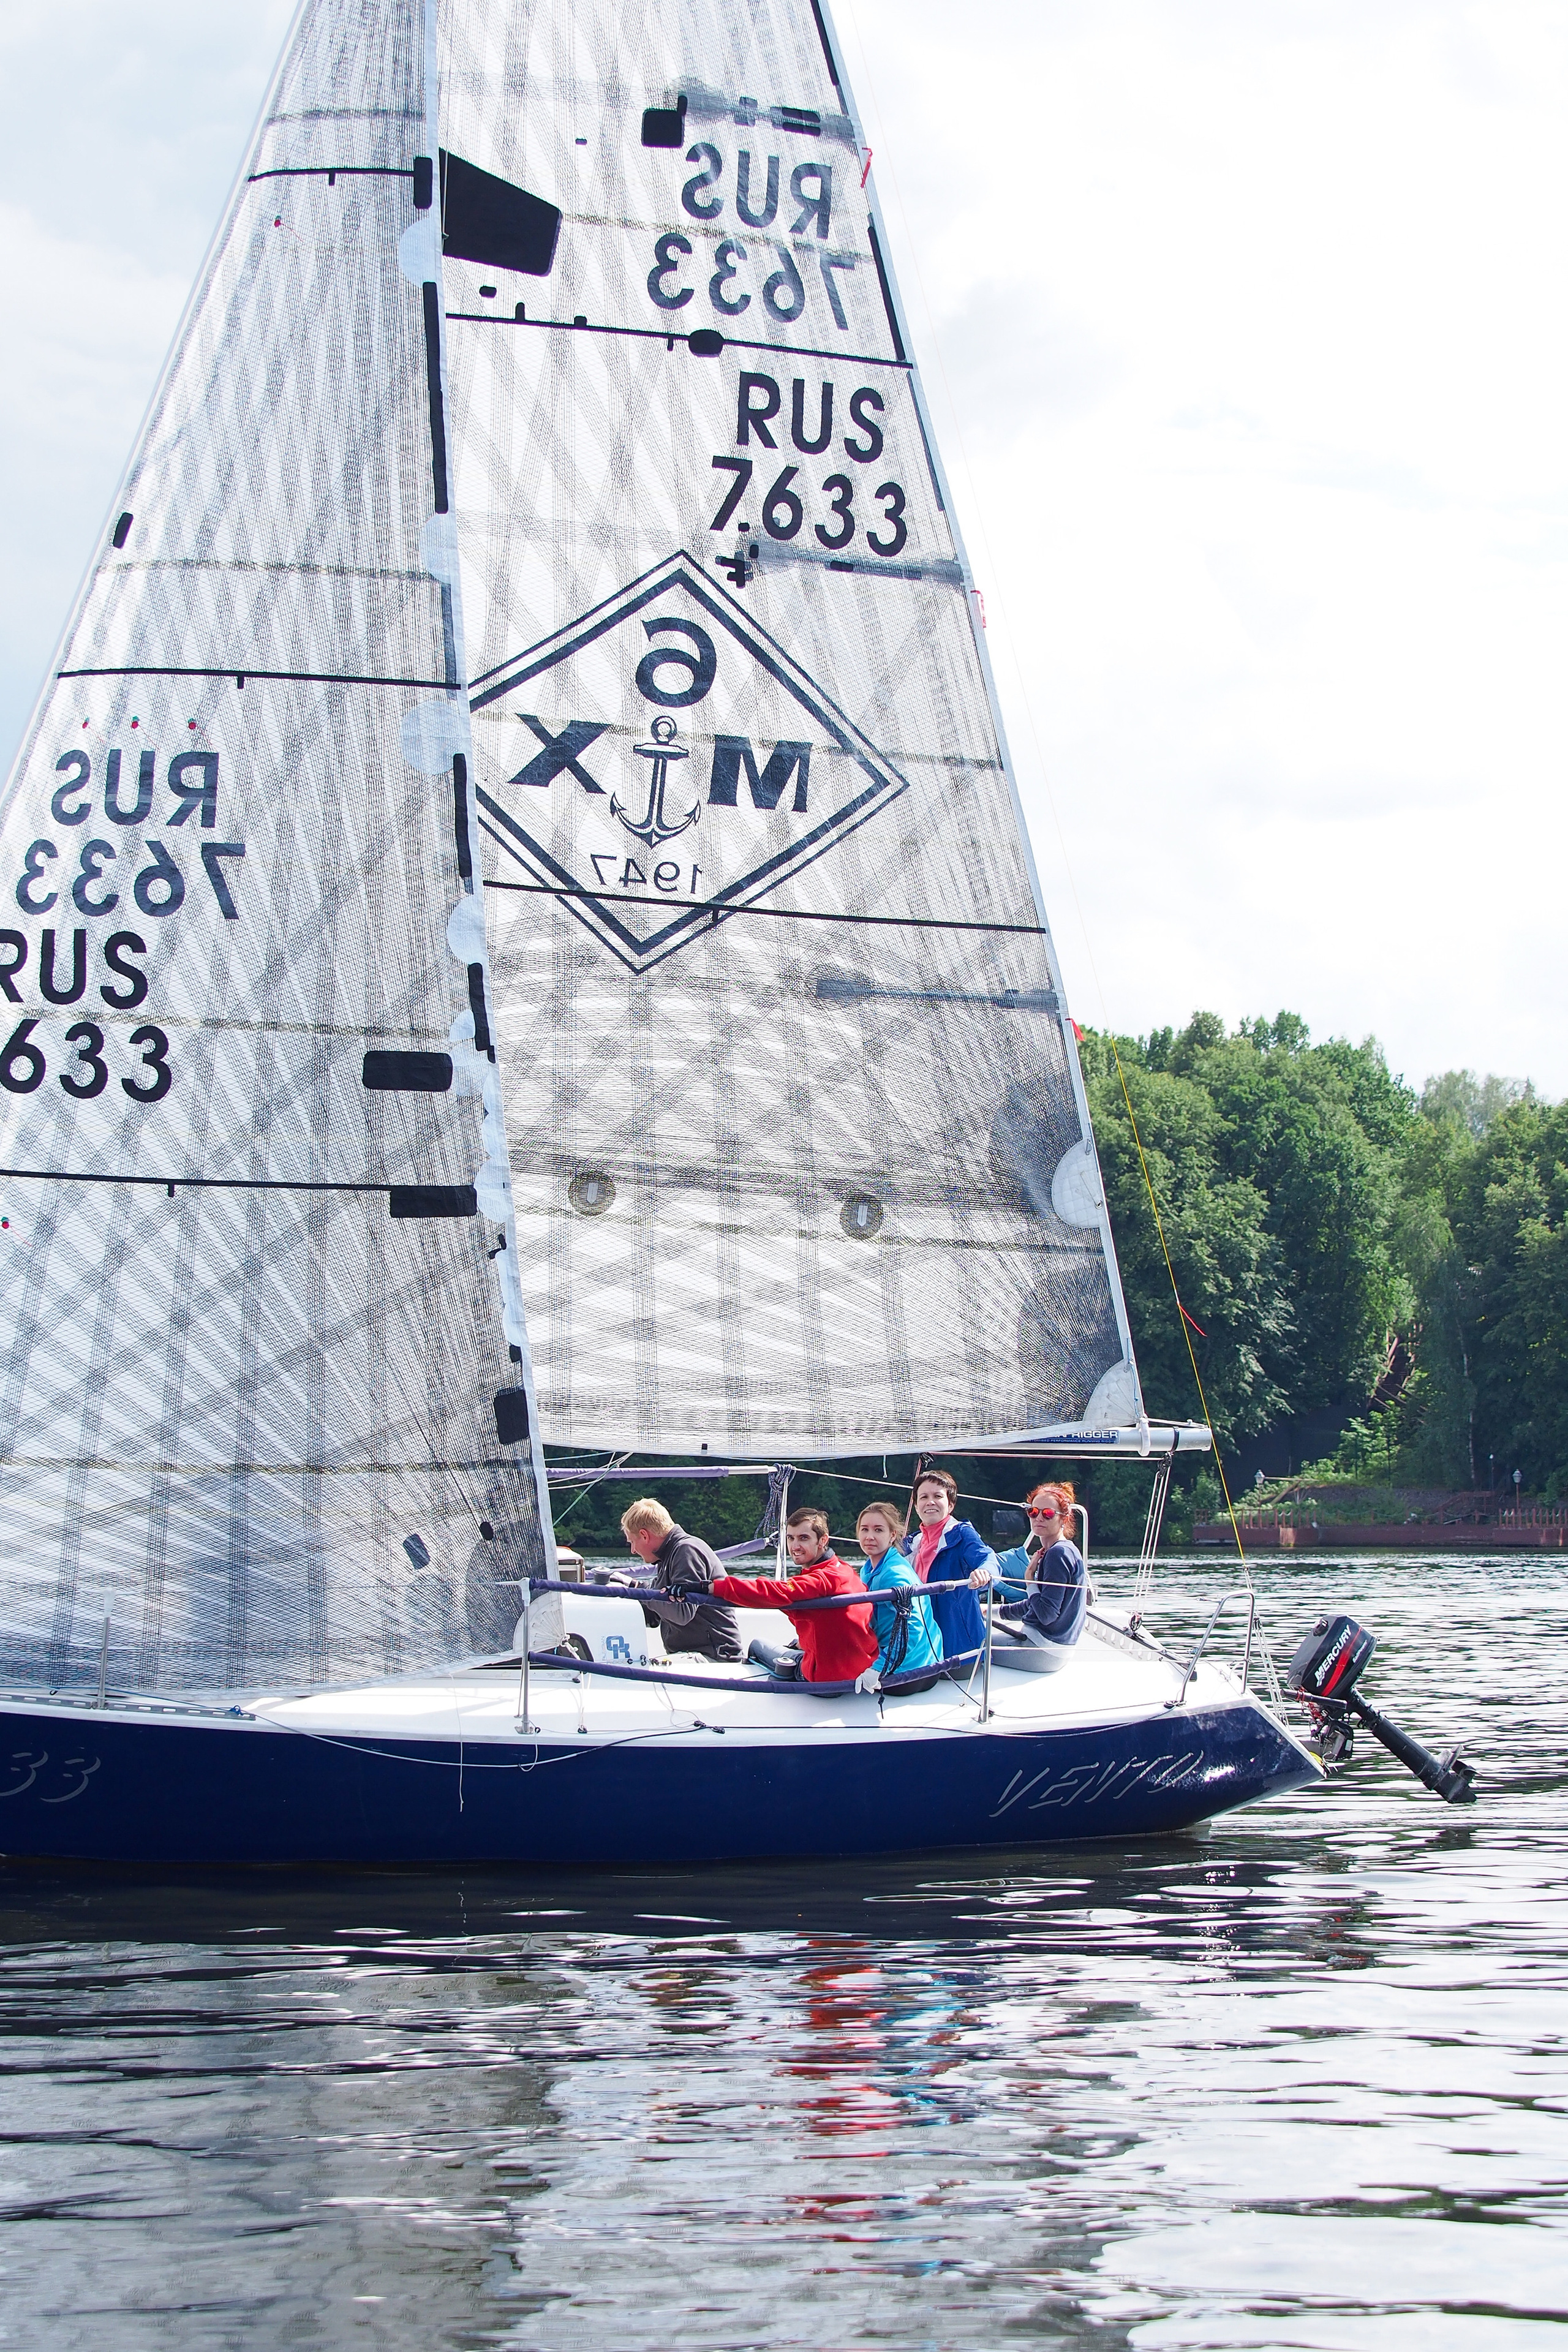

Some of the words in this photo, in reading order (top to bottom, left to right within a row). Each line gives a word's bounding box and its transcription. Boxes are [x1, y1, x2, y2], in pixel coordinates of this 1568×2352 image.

[736, 371, 884, 463] RUS
[709, 455, 908, 557] 7633
[0, 1019, 173, 1102] 633
[1072, 1430, 1118, 1439] RIGGER
[1314, 1624, 1351, 1687] MERCURY
[988, 1749, 1205, 1818] VENTO
